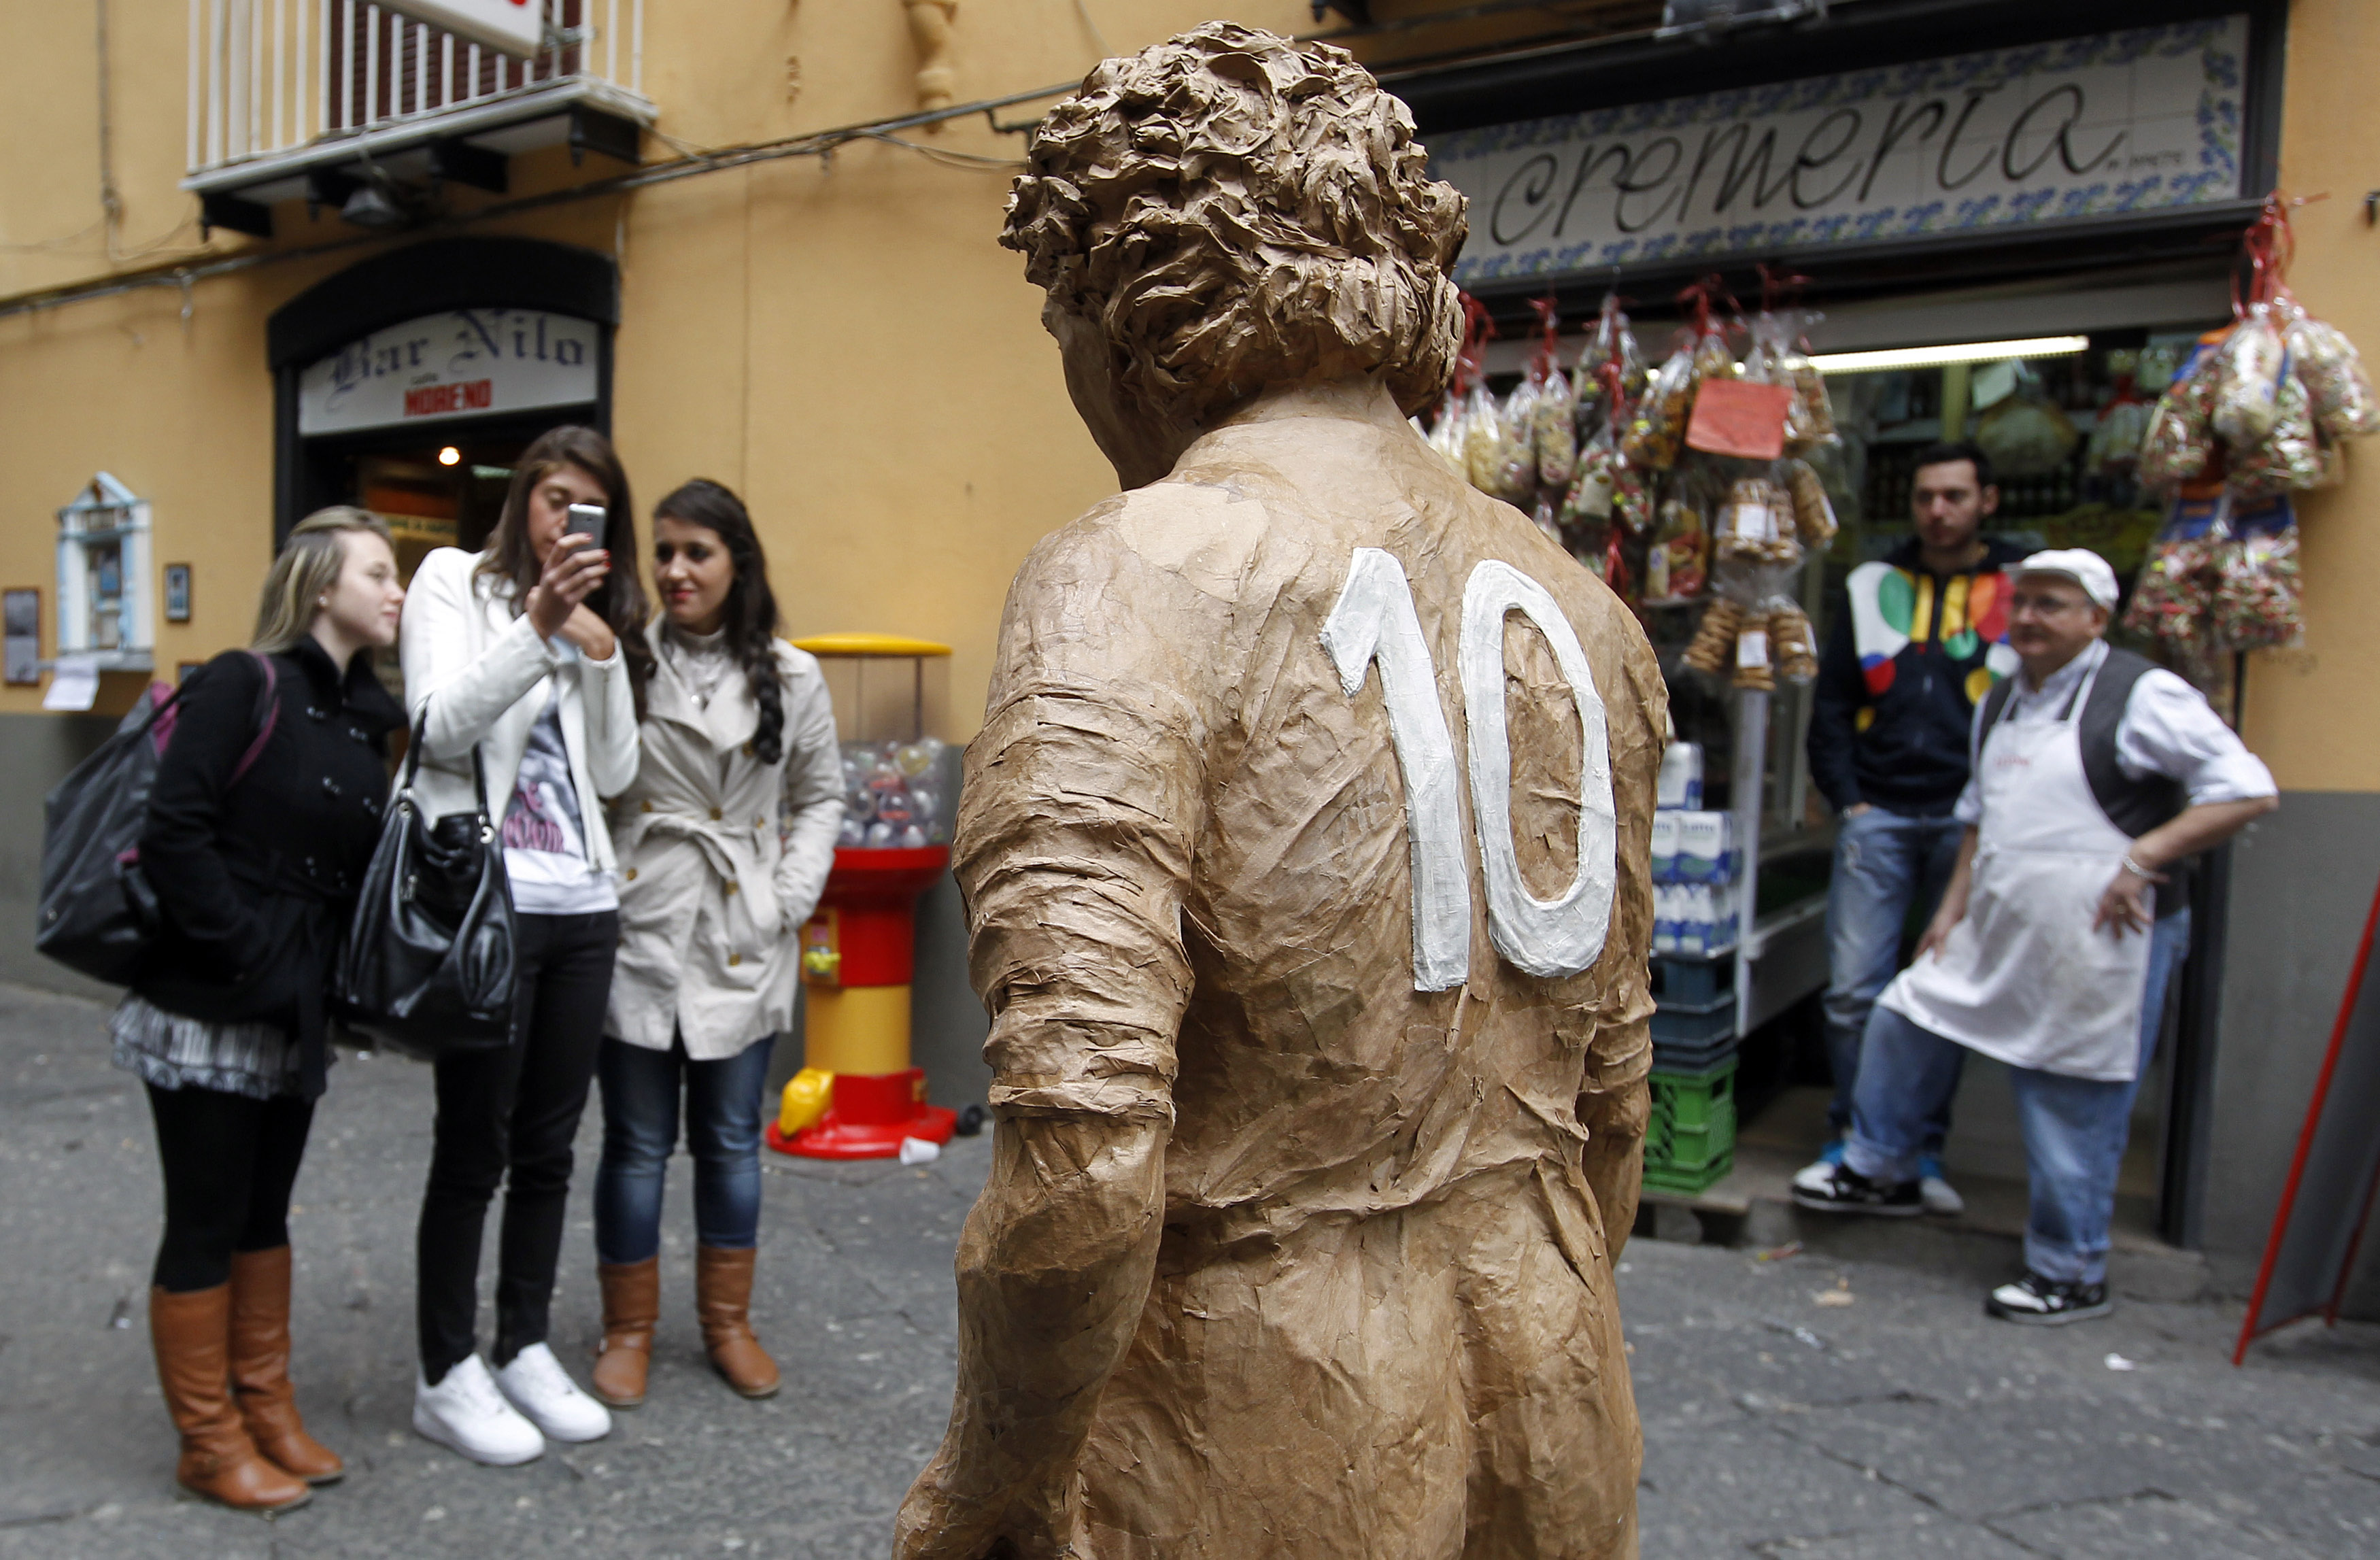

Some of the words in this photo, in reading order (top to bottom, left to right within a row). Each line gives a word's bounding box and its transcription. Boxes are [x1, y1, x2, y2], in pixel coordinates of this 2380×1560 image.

[1491, 78, 2127, 246] cremeria
[326, 339, 429, 412] Bar
[447, 309, 585, 374] Nilo
[405, 378, 492, 417] MORENO
[1319, 547, 1616, 992] 10
